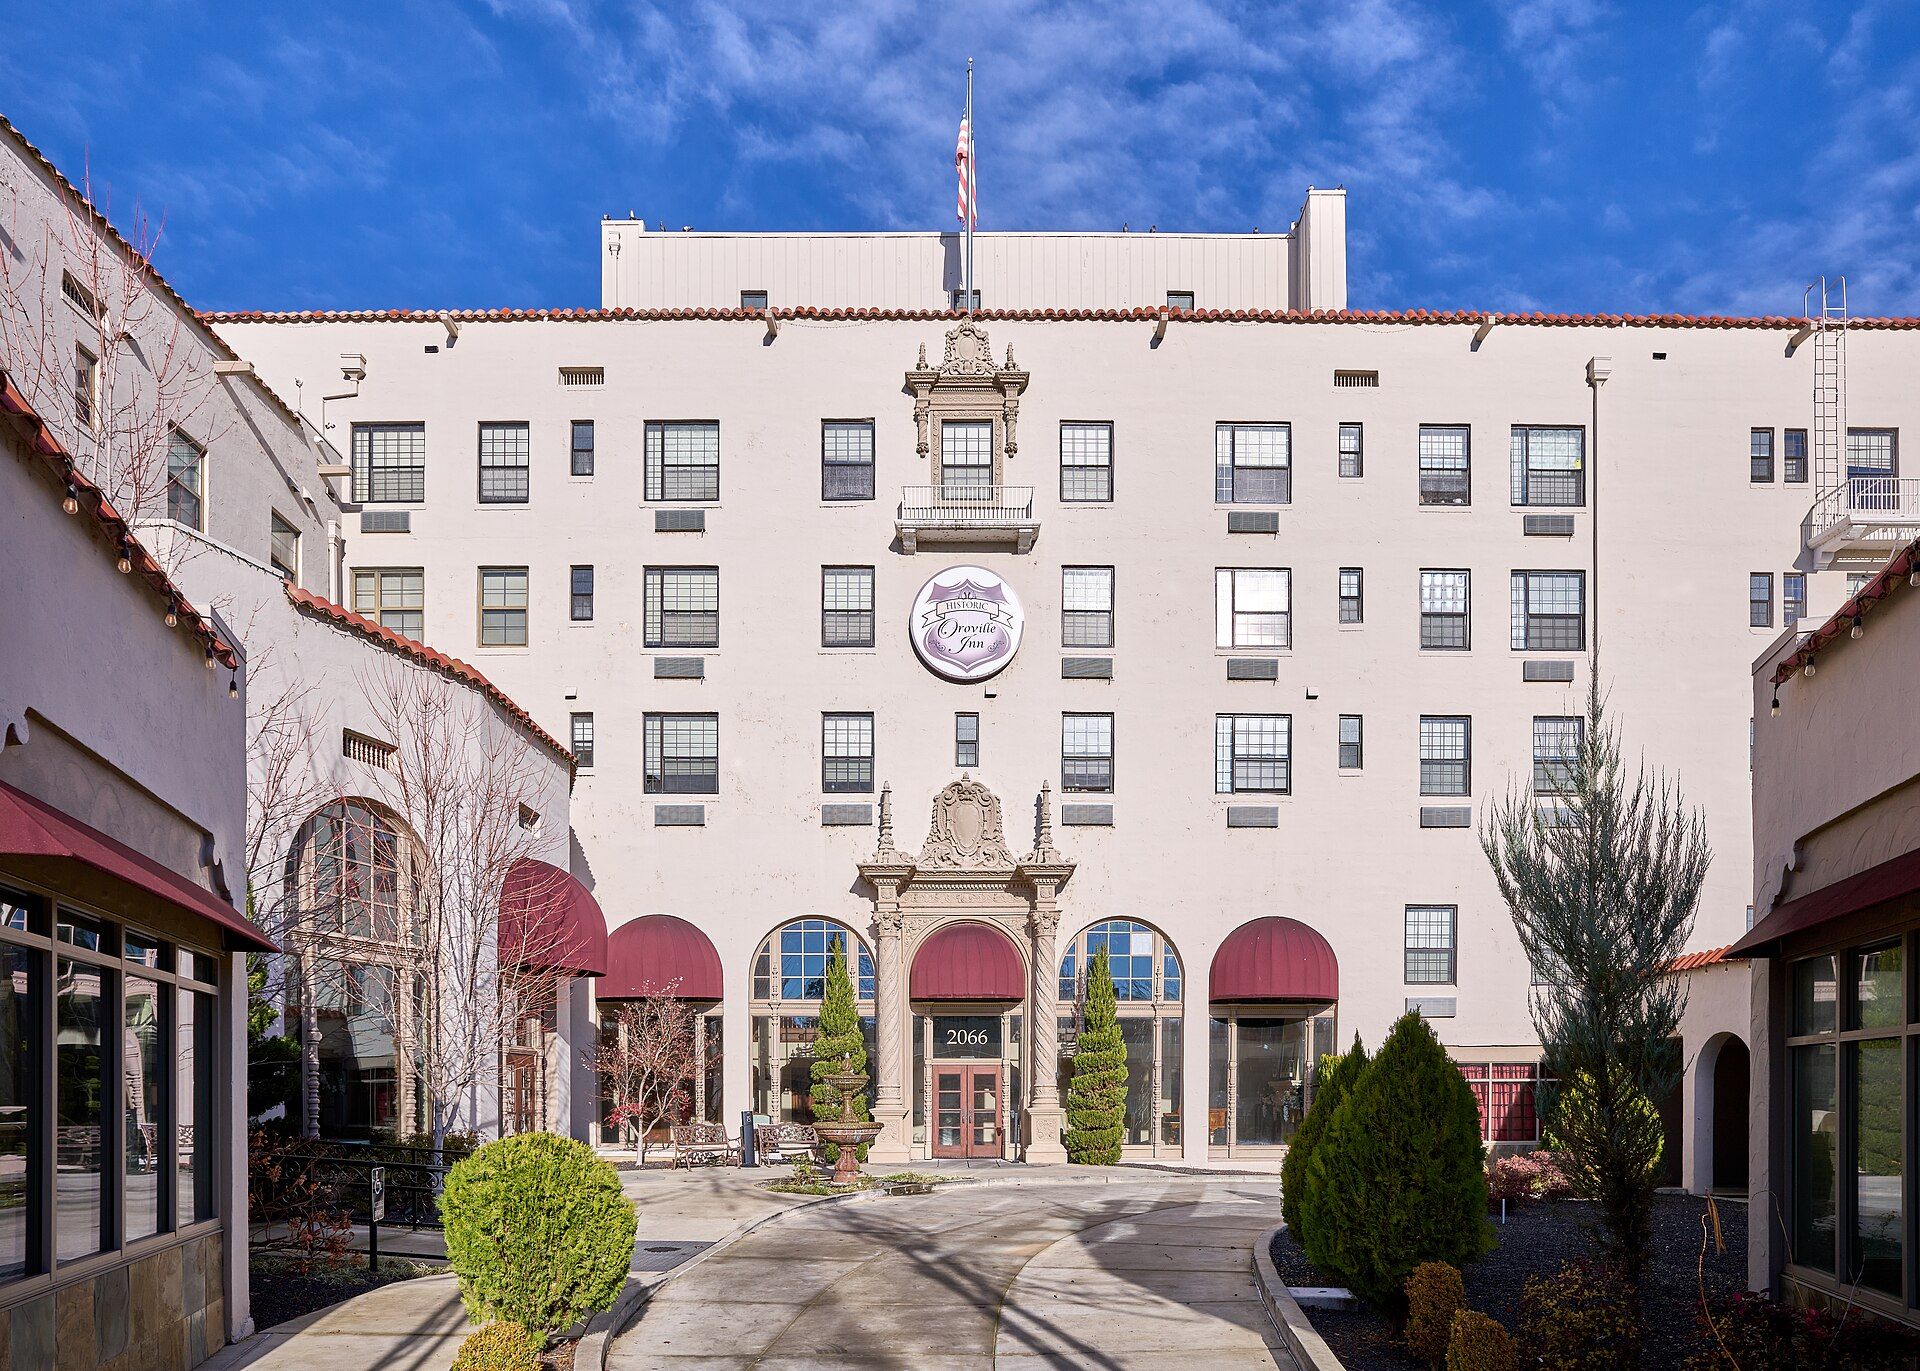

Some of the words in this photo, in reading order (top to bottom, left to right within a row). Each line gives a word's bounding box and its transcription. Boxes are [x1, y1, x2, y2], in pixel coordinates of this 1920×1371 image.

[946, 601, 988, 611] HISTORIC
[937, 618, 996, 639] Oroville
[948, 634, 984, 654] Inn
[946, 1029, 988, 1045] 2066
